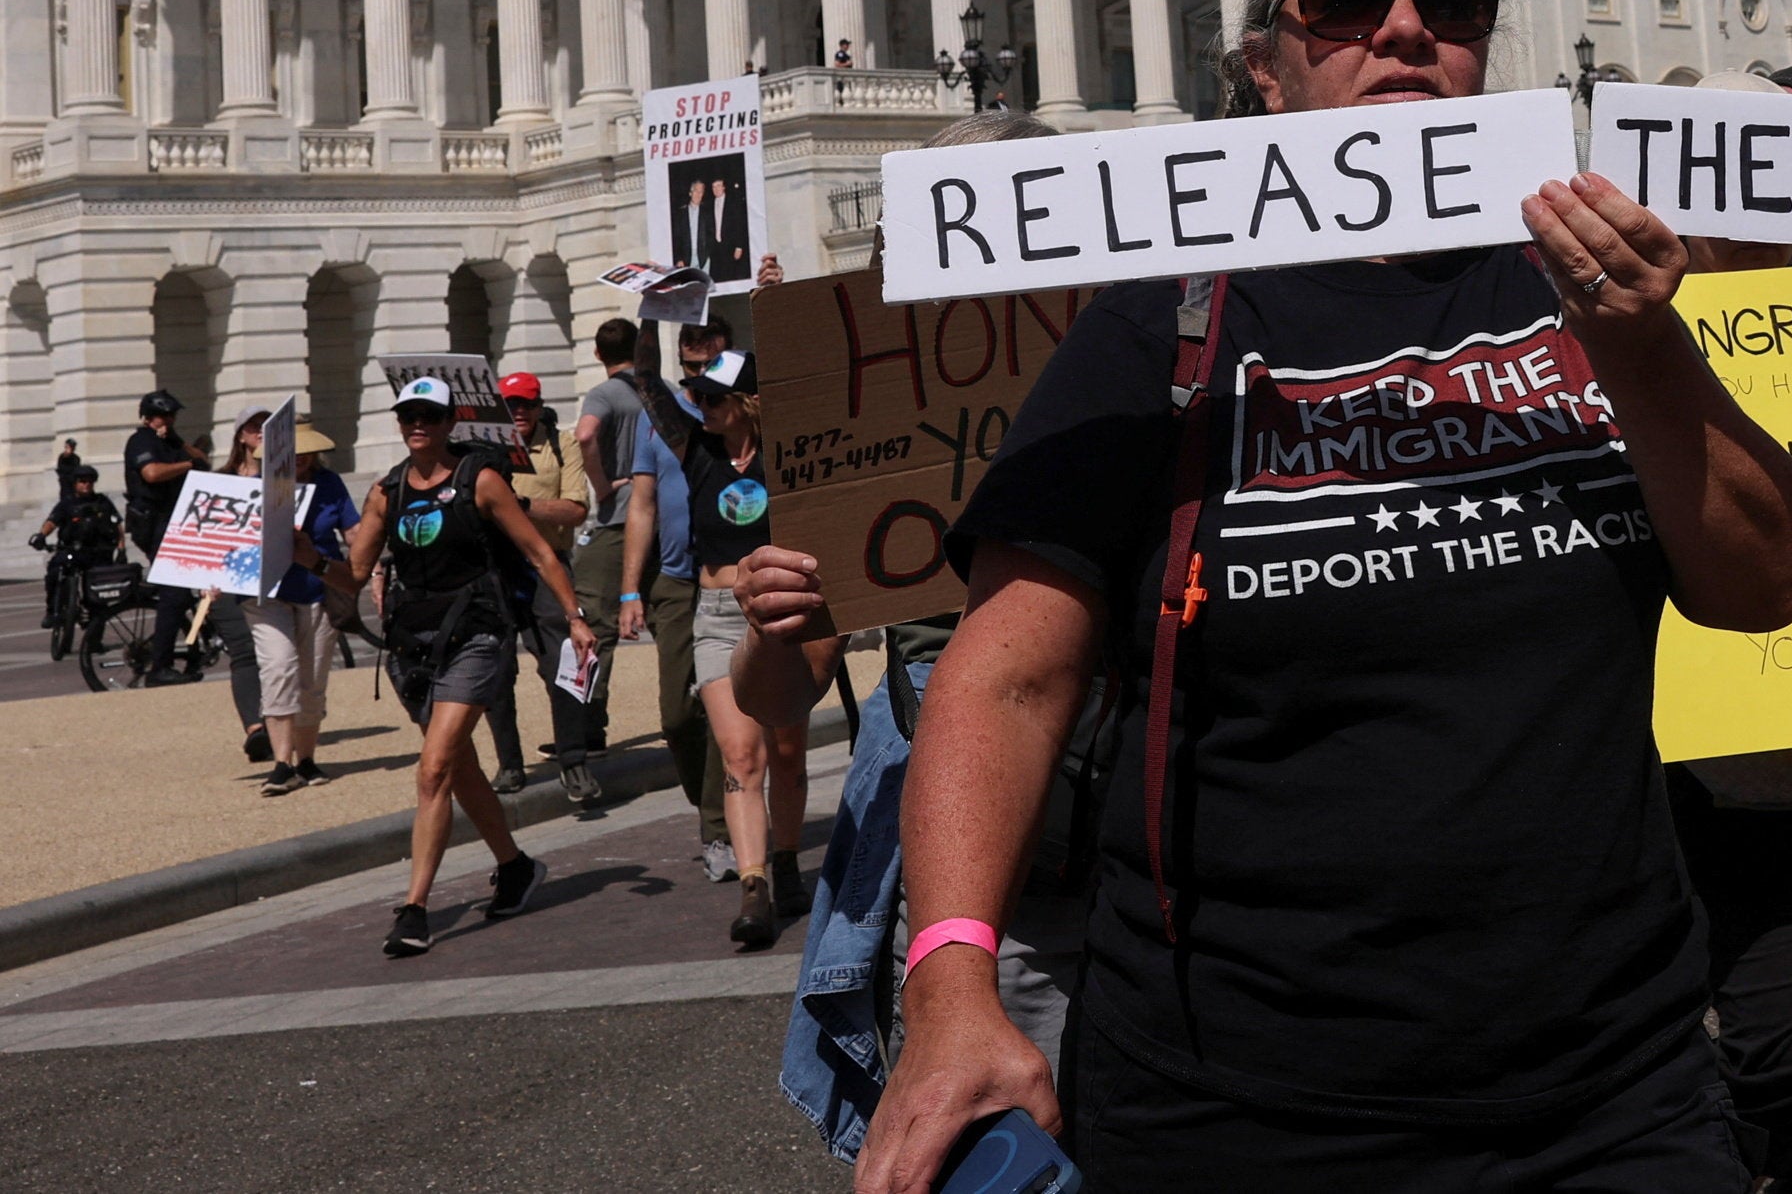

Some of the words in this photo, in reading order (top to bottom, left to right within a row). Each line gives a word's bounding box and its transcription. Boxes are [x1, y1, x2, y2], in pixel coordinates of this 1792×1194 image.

[648, 109, 758, 141] PROTECTING
[675, 91, 731, 118] STOP
[650, 129, 759, 160] PEDOPHILES
[930, 122, 1482, 269] RELEASE
[1616, 118, 1792, 214] THE
[832, 281, 1105, 419] HON
[1717, 374, 1754, 398] OU
[1297, 373, 1435, 435] KEEP
[1448, 345, 1563, 405] THE
[775, 428, 854, 471] 1-877-
[780, 435, 912, 489] 447-4487
[917, 406, 1010, 501] YO
[1254, 380, 1616, 476] IMMIGRANTS
[1226, 544, 1420, 601] DEPORT
[1431, 530, 1523, 573] THE
[1530, 509, 1653, 559] RACIS
